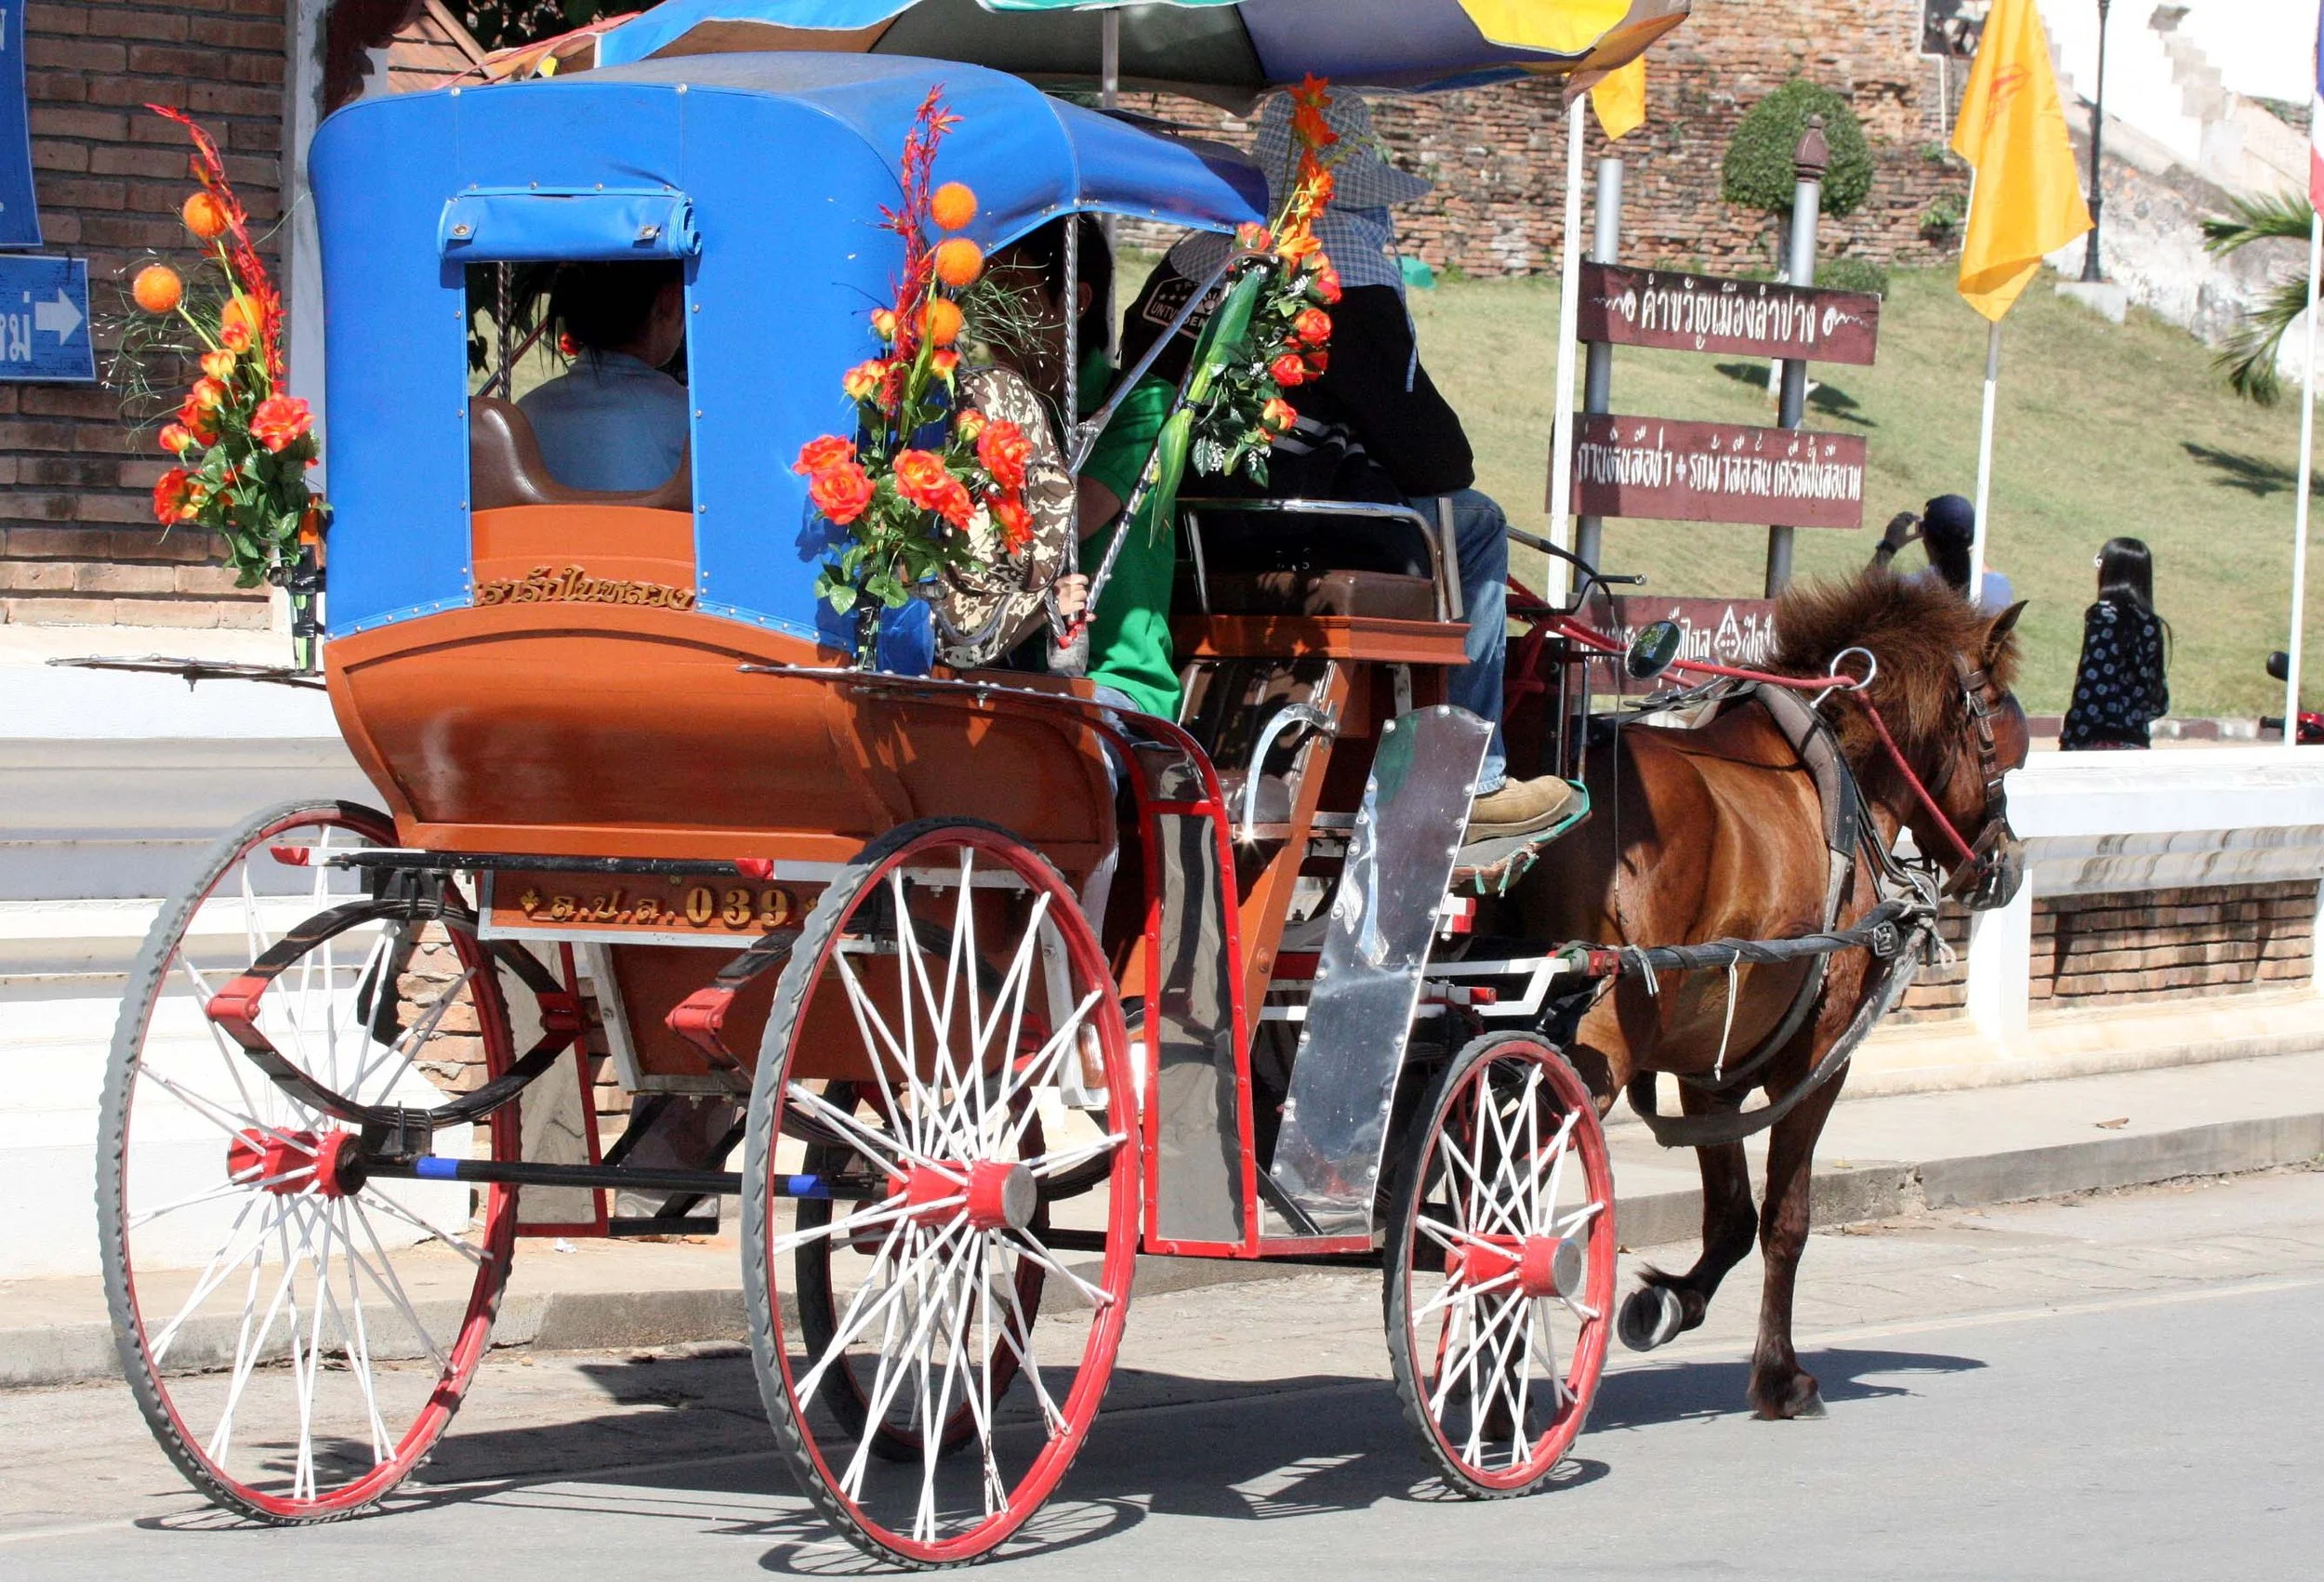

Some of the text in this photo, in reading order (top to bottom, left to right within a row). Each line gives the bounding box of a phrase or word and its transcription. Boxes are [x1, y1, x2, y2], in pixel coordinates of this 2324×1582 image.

[1642, 273, 1816, 349] คำขวัญเมืองลำปาง
[473, 564, 695, 611] เรารักในหลวง
[686, 887, 789, 927] 039
